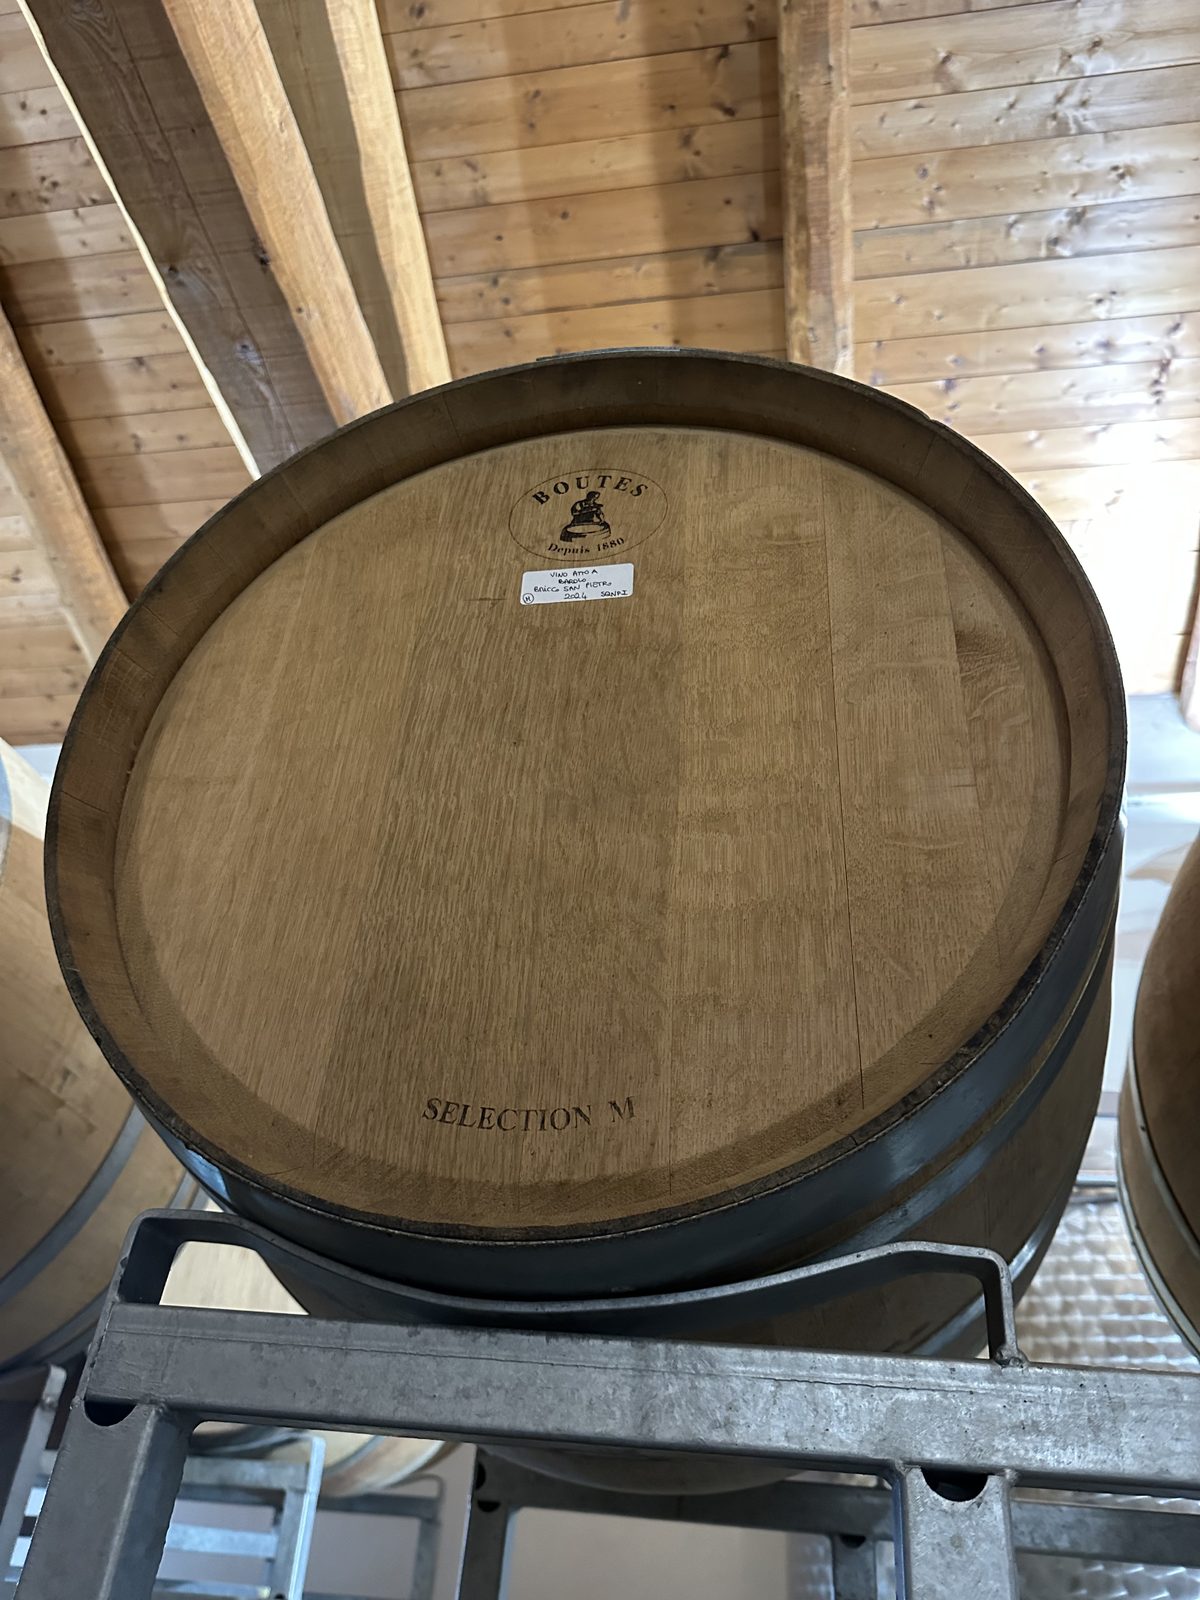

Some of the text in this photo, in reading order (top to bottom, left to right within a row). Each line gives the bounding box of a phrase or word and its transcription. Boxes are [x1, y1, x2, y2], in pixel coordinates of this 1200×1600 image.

[532, 475, 649, 505] BOUTES
[547, 537, 625, 556] Depuis 1880
[563, 592, 587, 600] 2024
[421, 1096, 635, 1132] SELECTION M
